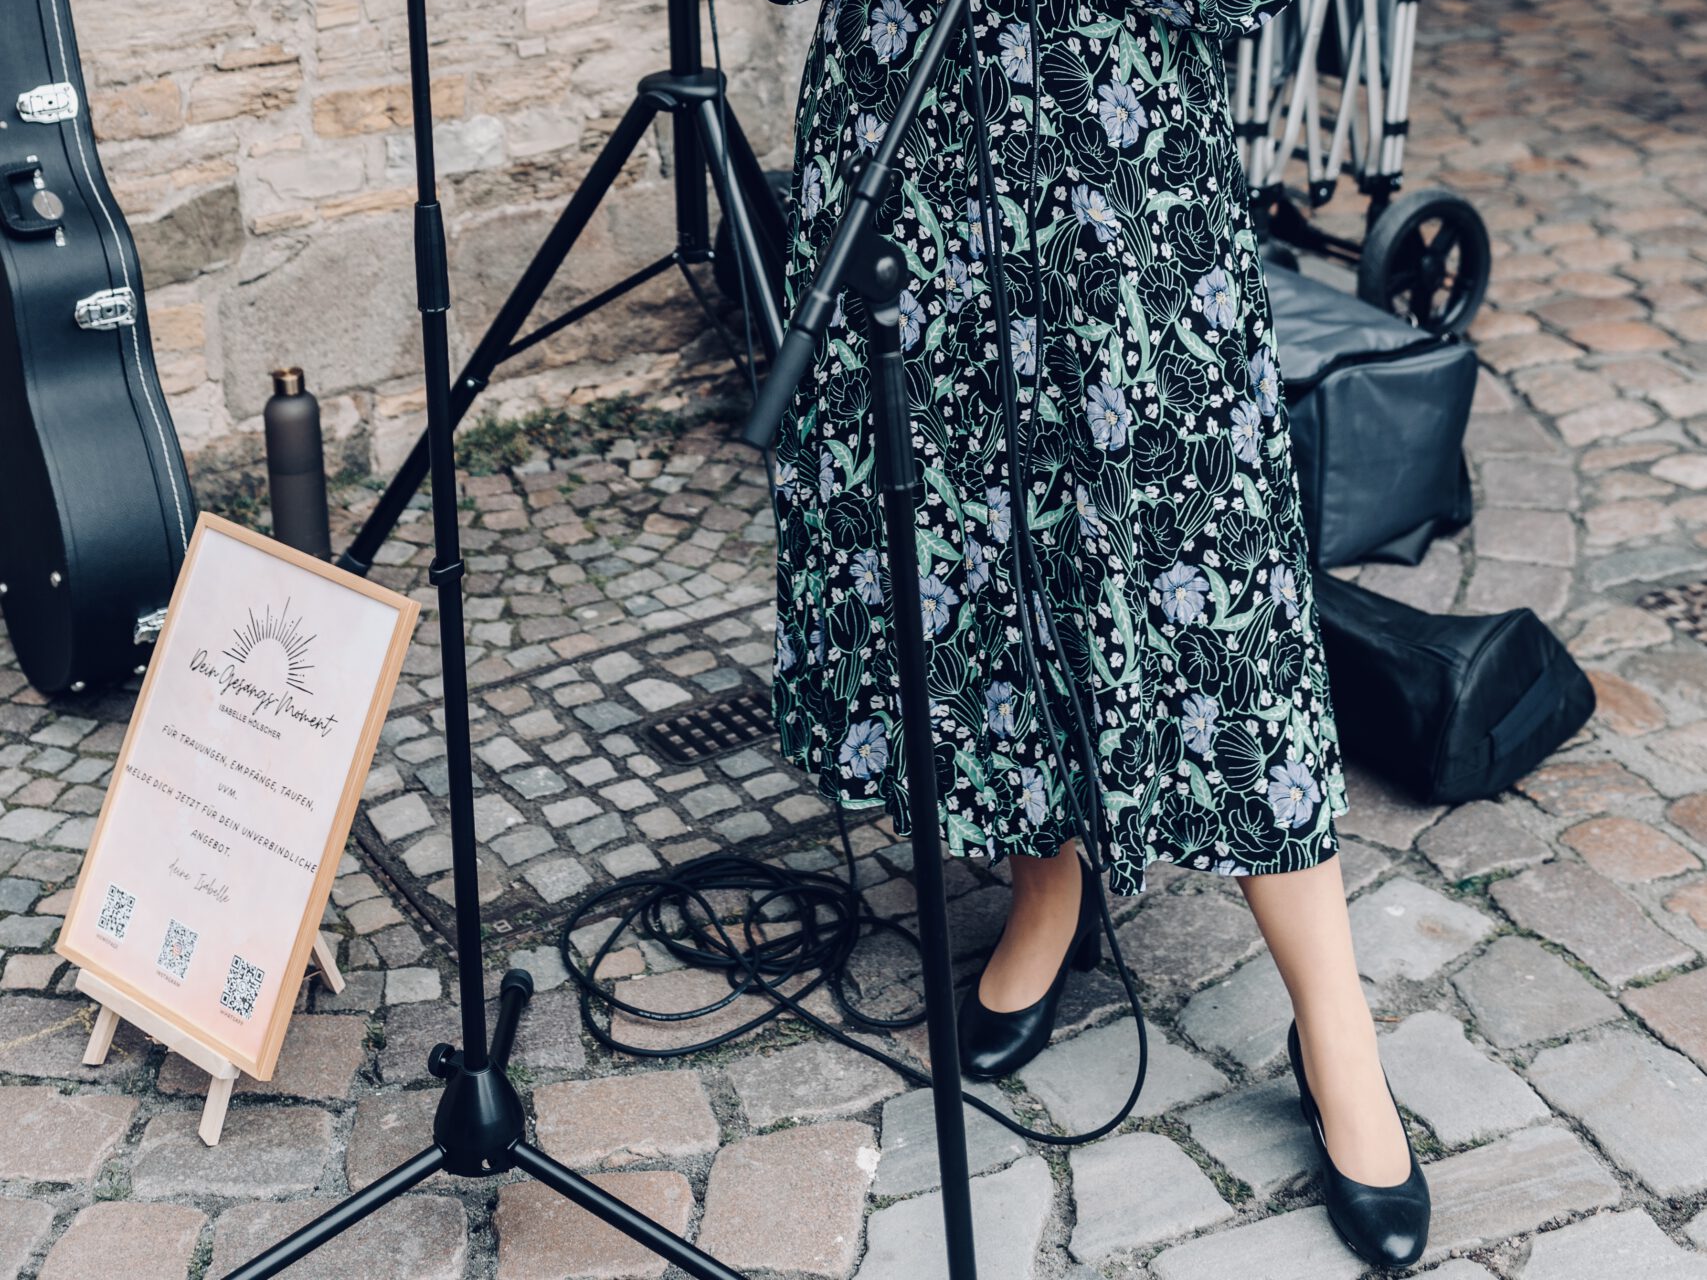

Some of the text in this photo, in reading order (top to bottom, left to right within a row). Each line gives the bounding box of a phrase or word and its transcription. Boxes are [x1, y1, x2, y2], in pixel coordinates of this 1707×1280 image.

[189, 648, 219, 677] Dein
[219, 704, 281, 739] ISABELLE HÖLSCHER
[162, 724, 314, 811] FÜR TRAUUNGEN, EMPFÄNGE, TAUFEN,
[126, 764, 152, 784] MELDE
[153, 779, 174, 796] DICH
[175, 791, 201, 809] JETZT
[202, 804, 218, 819] FÜR
[219, 815, 240, 831] DEIN
[217, 783, 237, 800] UVM.
[190, 829, 230, 856] ANGEBOT.
[193, 873, 230, 903] Isabelle
